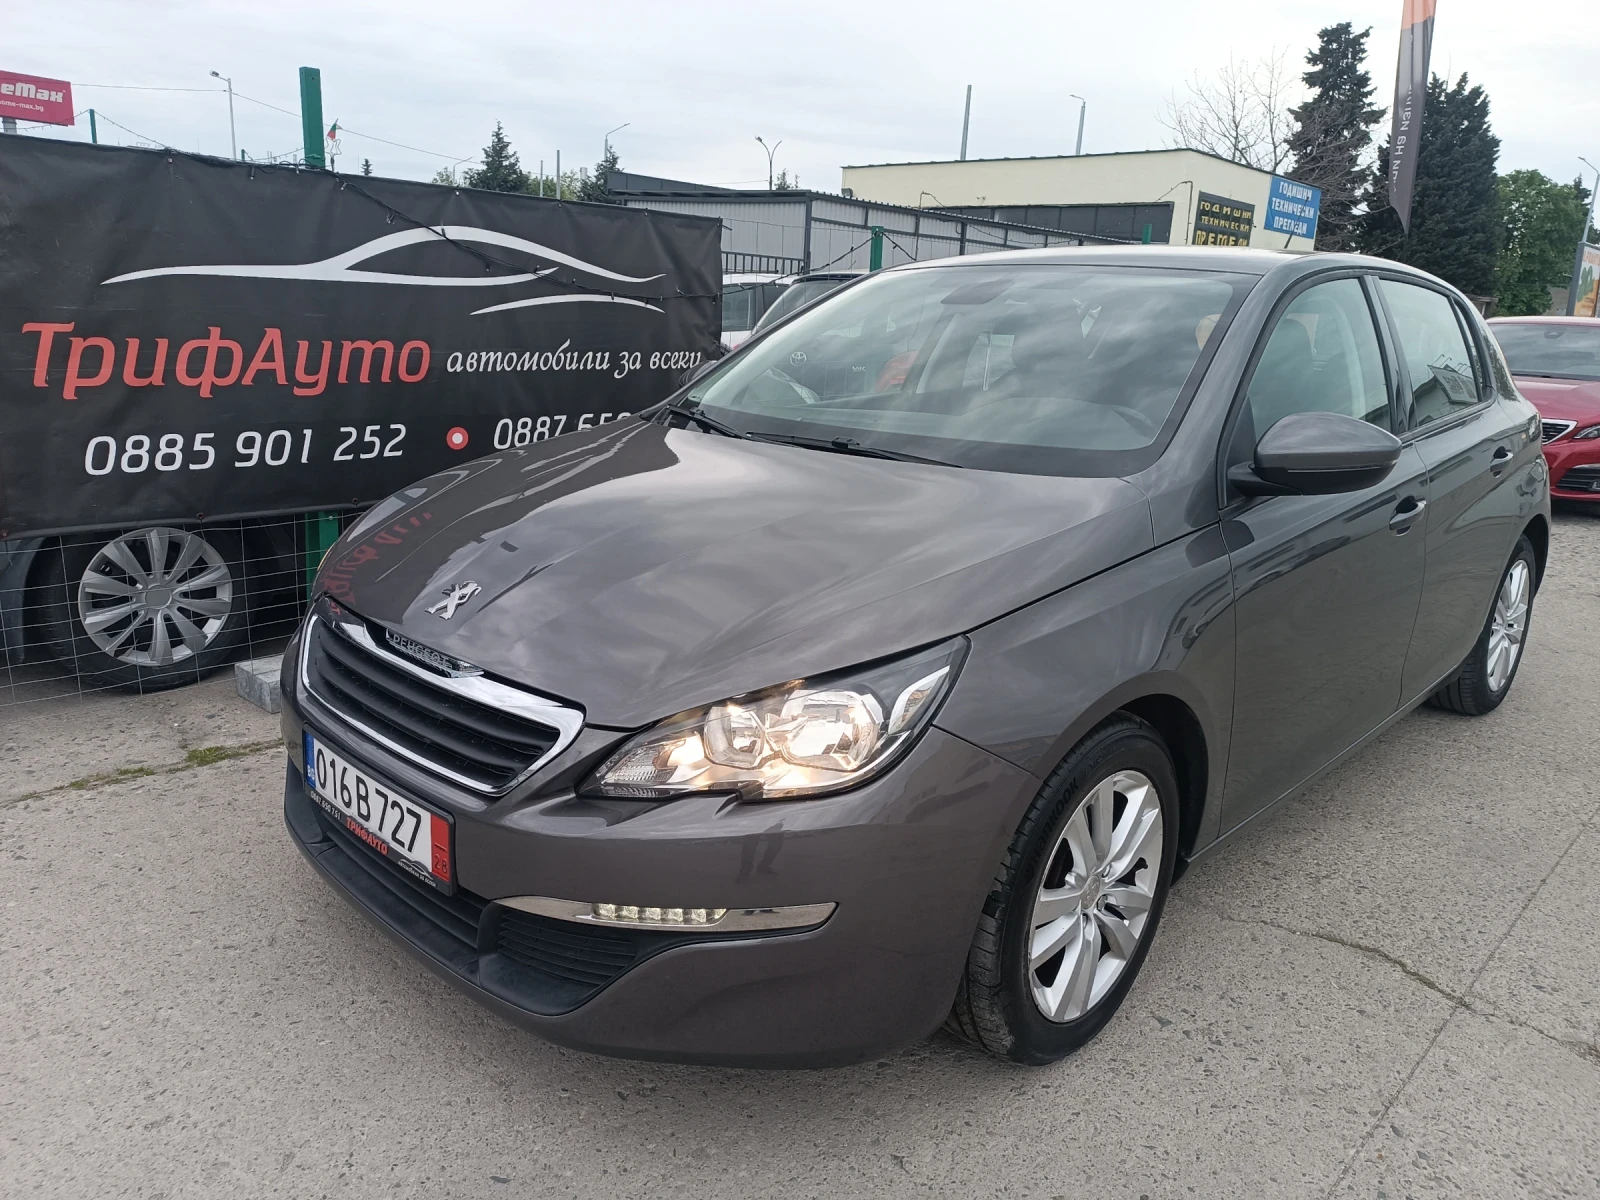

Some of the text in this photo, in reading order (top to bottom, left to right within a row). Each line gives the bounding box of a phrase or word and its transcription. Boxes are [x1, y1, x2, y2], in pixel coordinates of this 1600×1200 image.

[0, 100, 44, 112] ome-max.bg
[1271, 197, 1314, 219] ТЕХНИЧЕСКИ
[1279, 181, 1312, 201] ГОДИШНИ
[446, 338, 702, 379] автомобили за всеки
[84, 423, 407, 476] 0885 901 252
[493, 415, 567, 450] 0887
[346, 816, 388, 856] ТРИФАУТО
